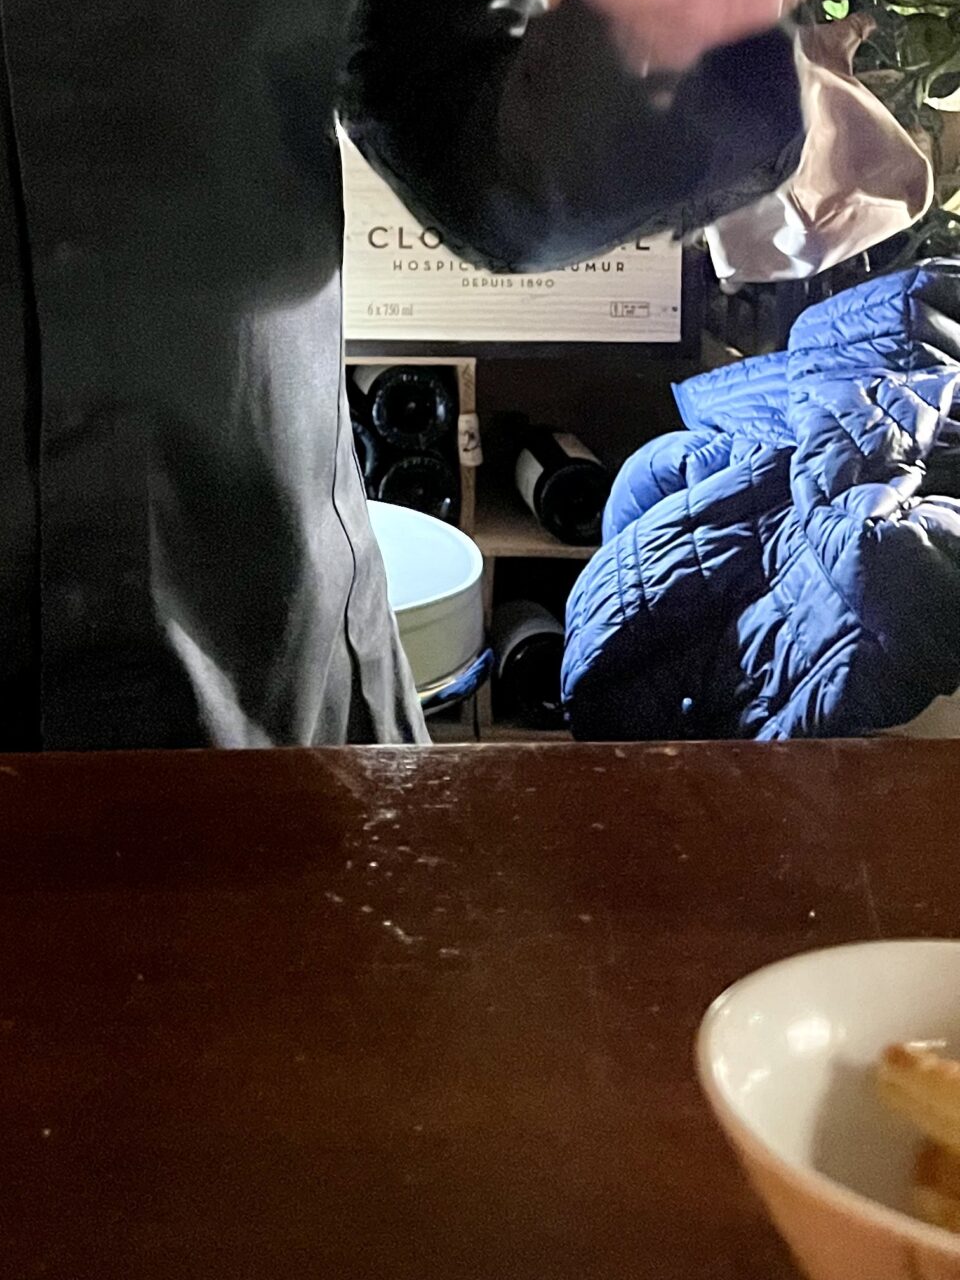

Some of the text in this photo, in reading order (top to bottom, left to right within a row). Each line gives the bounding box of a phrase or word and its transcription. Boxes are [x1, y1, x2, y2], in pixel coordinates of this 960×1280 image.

[562, 261, 625, 272] UMUR
[461, 278, 556, 289] DEPUIS 1890
[367, 302, 373, 316] 6
[384, 304, 400, 316] 750
[401, 304, 414, 316] ml
